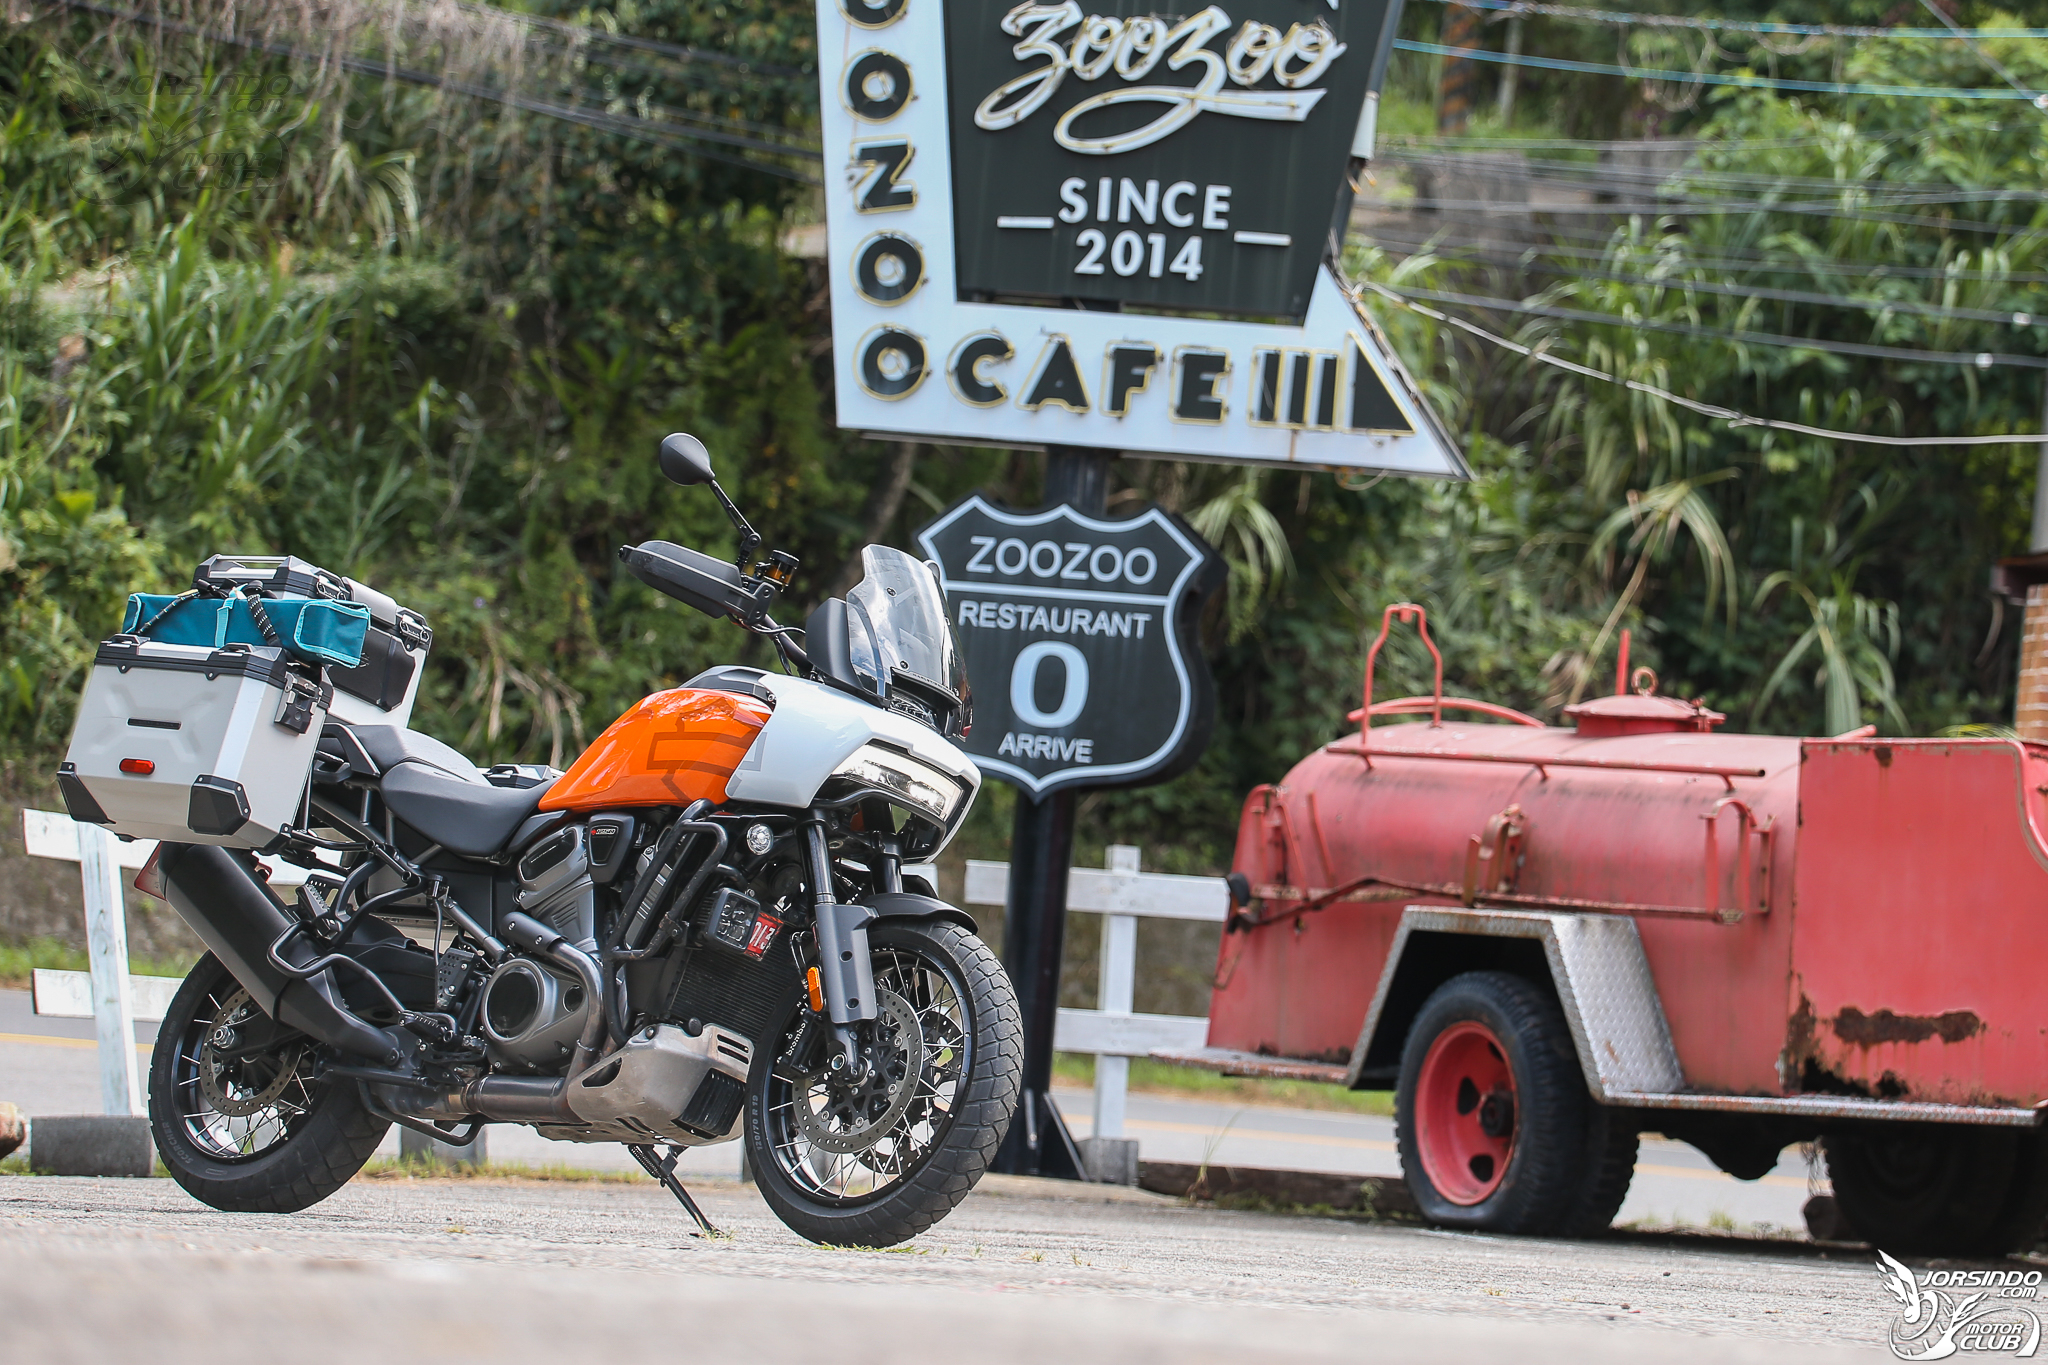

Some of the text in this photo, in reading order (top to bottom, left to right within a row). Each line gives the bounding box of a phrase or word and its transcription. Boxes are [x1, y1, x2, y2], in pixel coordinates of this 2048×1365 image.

[1058, 176, 1232, 230] SINCE
[1074, 228, 1204, 281] 2014
[947, 330, 1232, 424] CAFE
[966, 535, 1158, 585] ZOOZOO
[958, 600, 1152, 640] RESTAURANT
[998, 731, 1094, 764] ARRIVE
[162, 1121, 194, 1164] SCORCHER
[752, 1118, 763, 1150] 120/70
